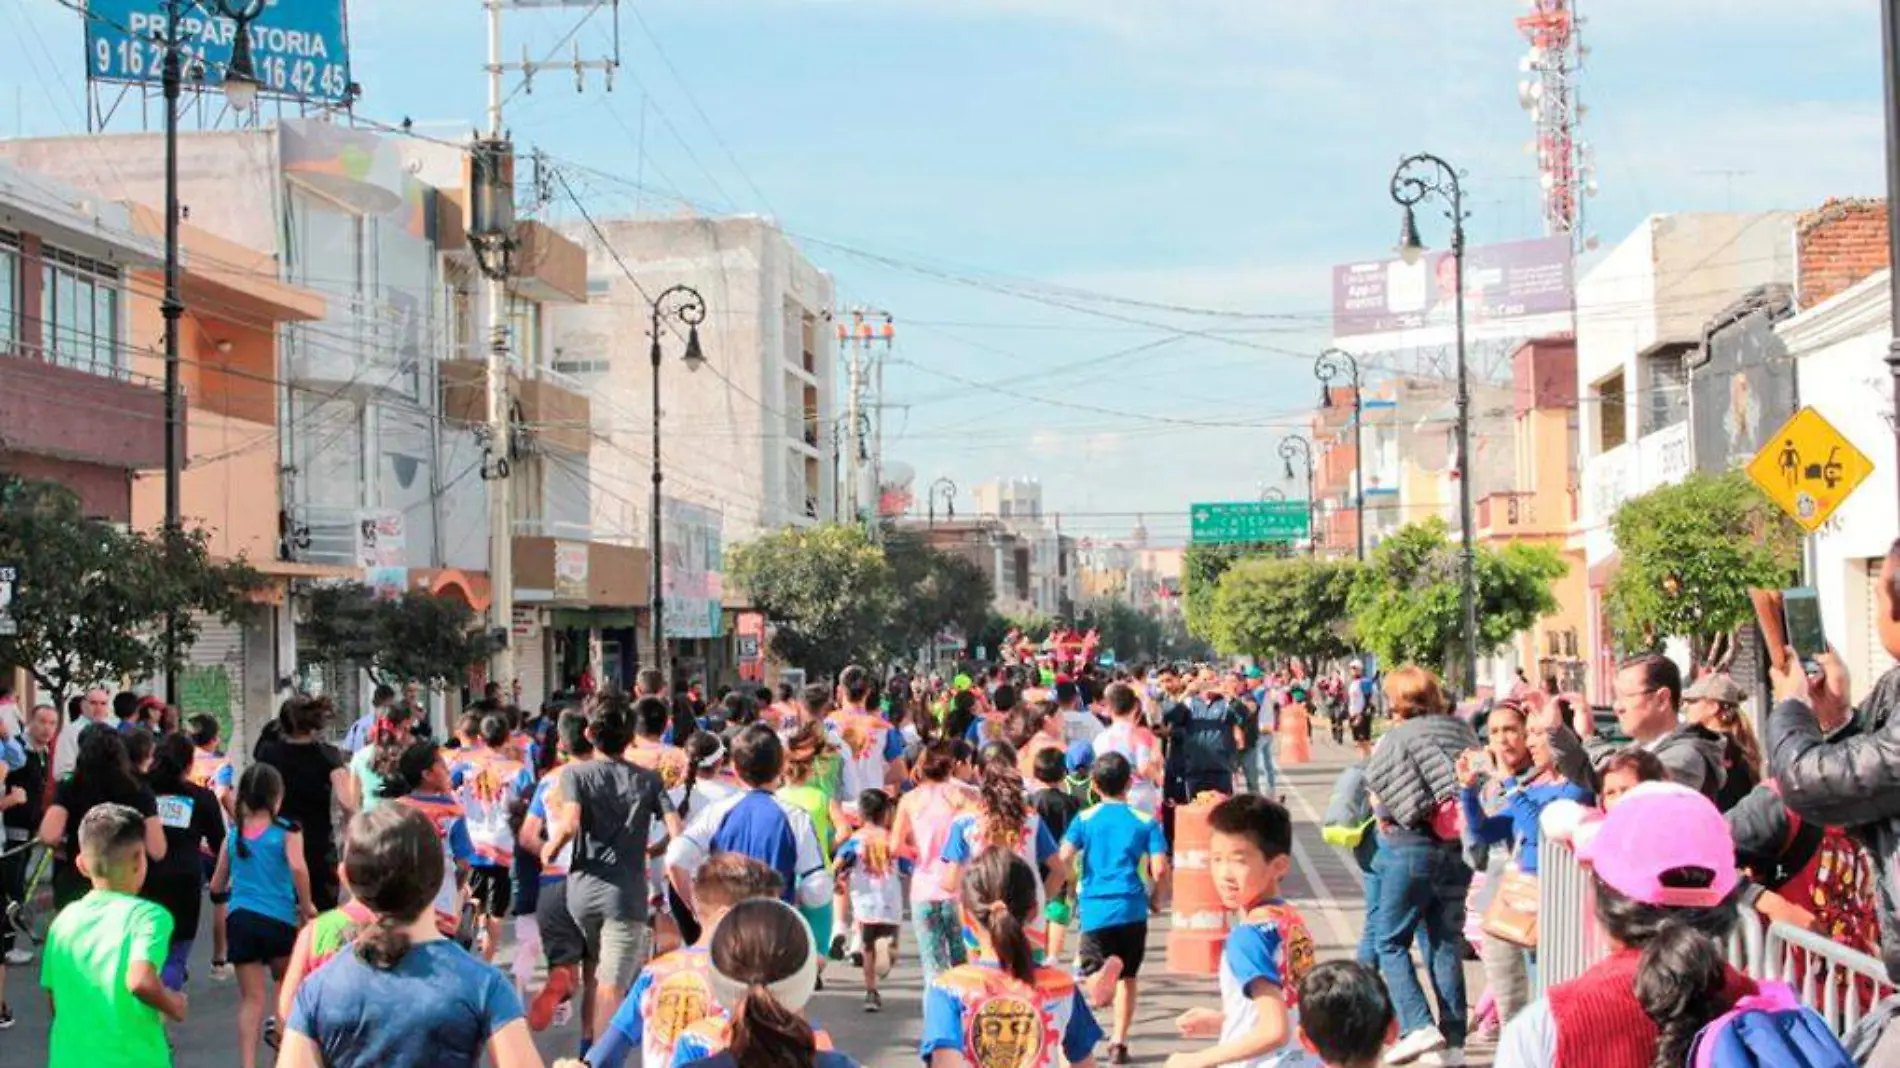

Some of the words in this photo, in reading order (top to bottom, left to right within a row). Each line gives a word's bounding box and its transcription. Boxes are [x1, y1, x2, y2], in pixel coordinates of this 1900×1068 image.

[96, 37, 110, 72] 9
[118, 39, 143, 75] 16
[262, 56, 286, 89] 16
[290, 59, 315, 93] 42
[321, 64, 345, 97] 45
